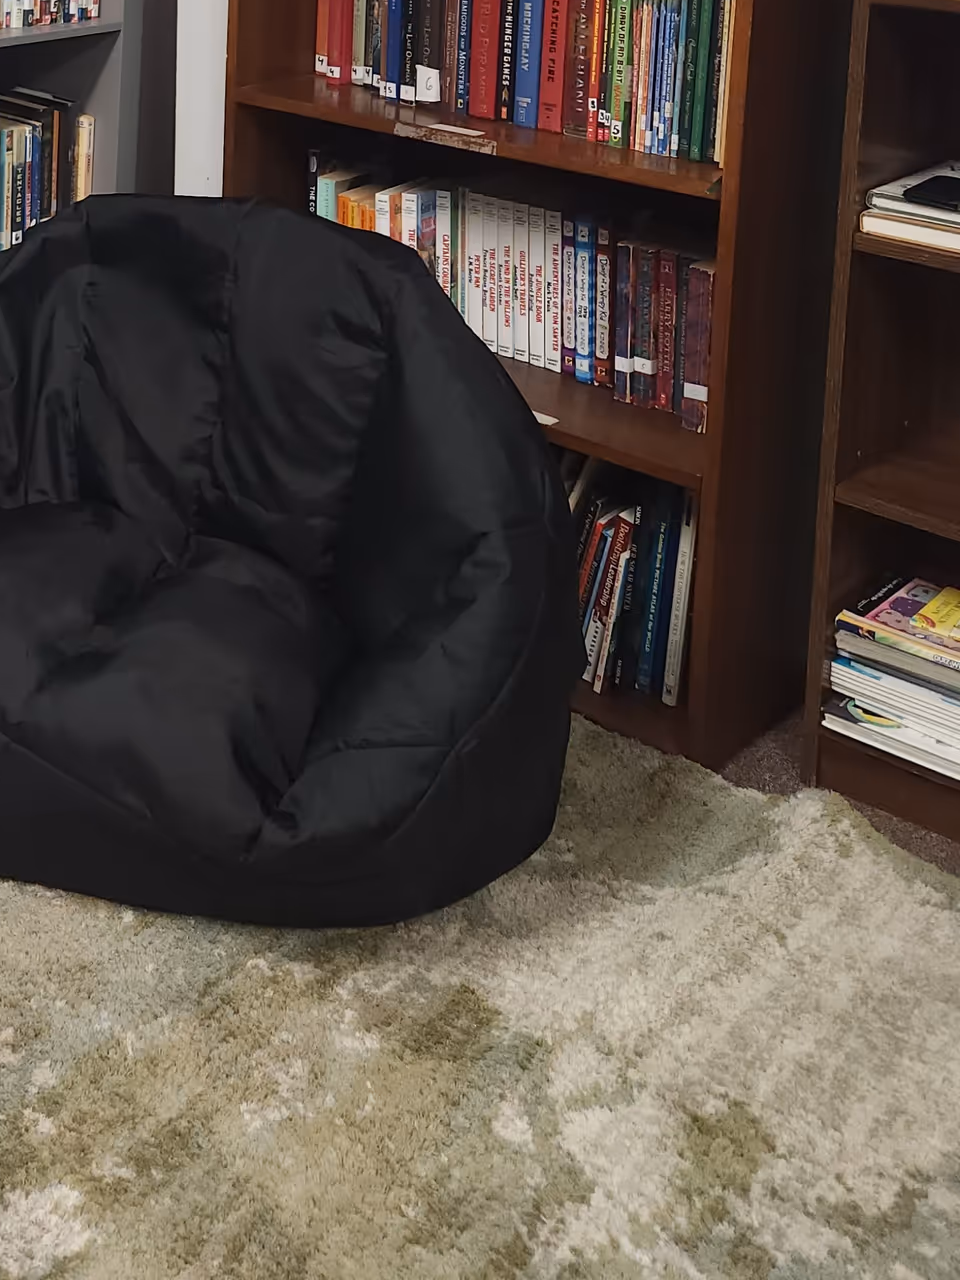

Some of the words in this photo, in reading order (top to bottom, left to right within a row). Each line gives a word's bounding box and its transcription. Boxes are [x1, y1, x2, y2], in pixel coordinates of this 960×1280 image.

[504, 16, 513, 53] HUNGER
[521, 2, 532, 71] MOCKINGJAY
[549, 0, 560, 53] CATCHING
[458, 50, 466, 94] MONSTERS
[502, 56, 511, 85] GAMES
[548, 58, 557, 82] FIRE
[552, 301, 559, 309] OF
[663, 287, 672, 328] HARRY
[663, 332, 672, 373] POTTER
[610, 522, 630, 563] Bootstrap
[600, 564, 618, 607] Leadership
